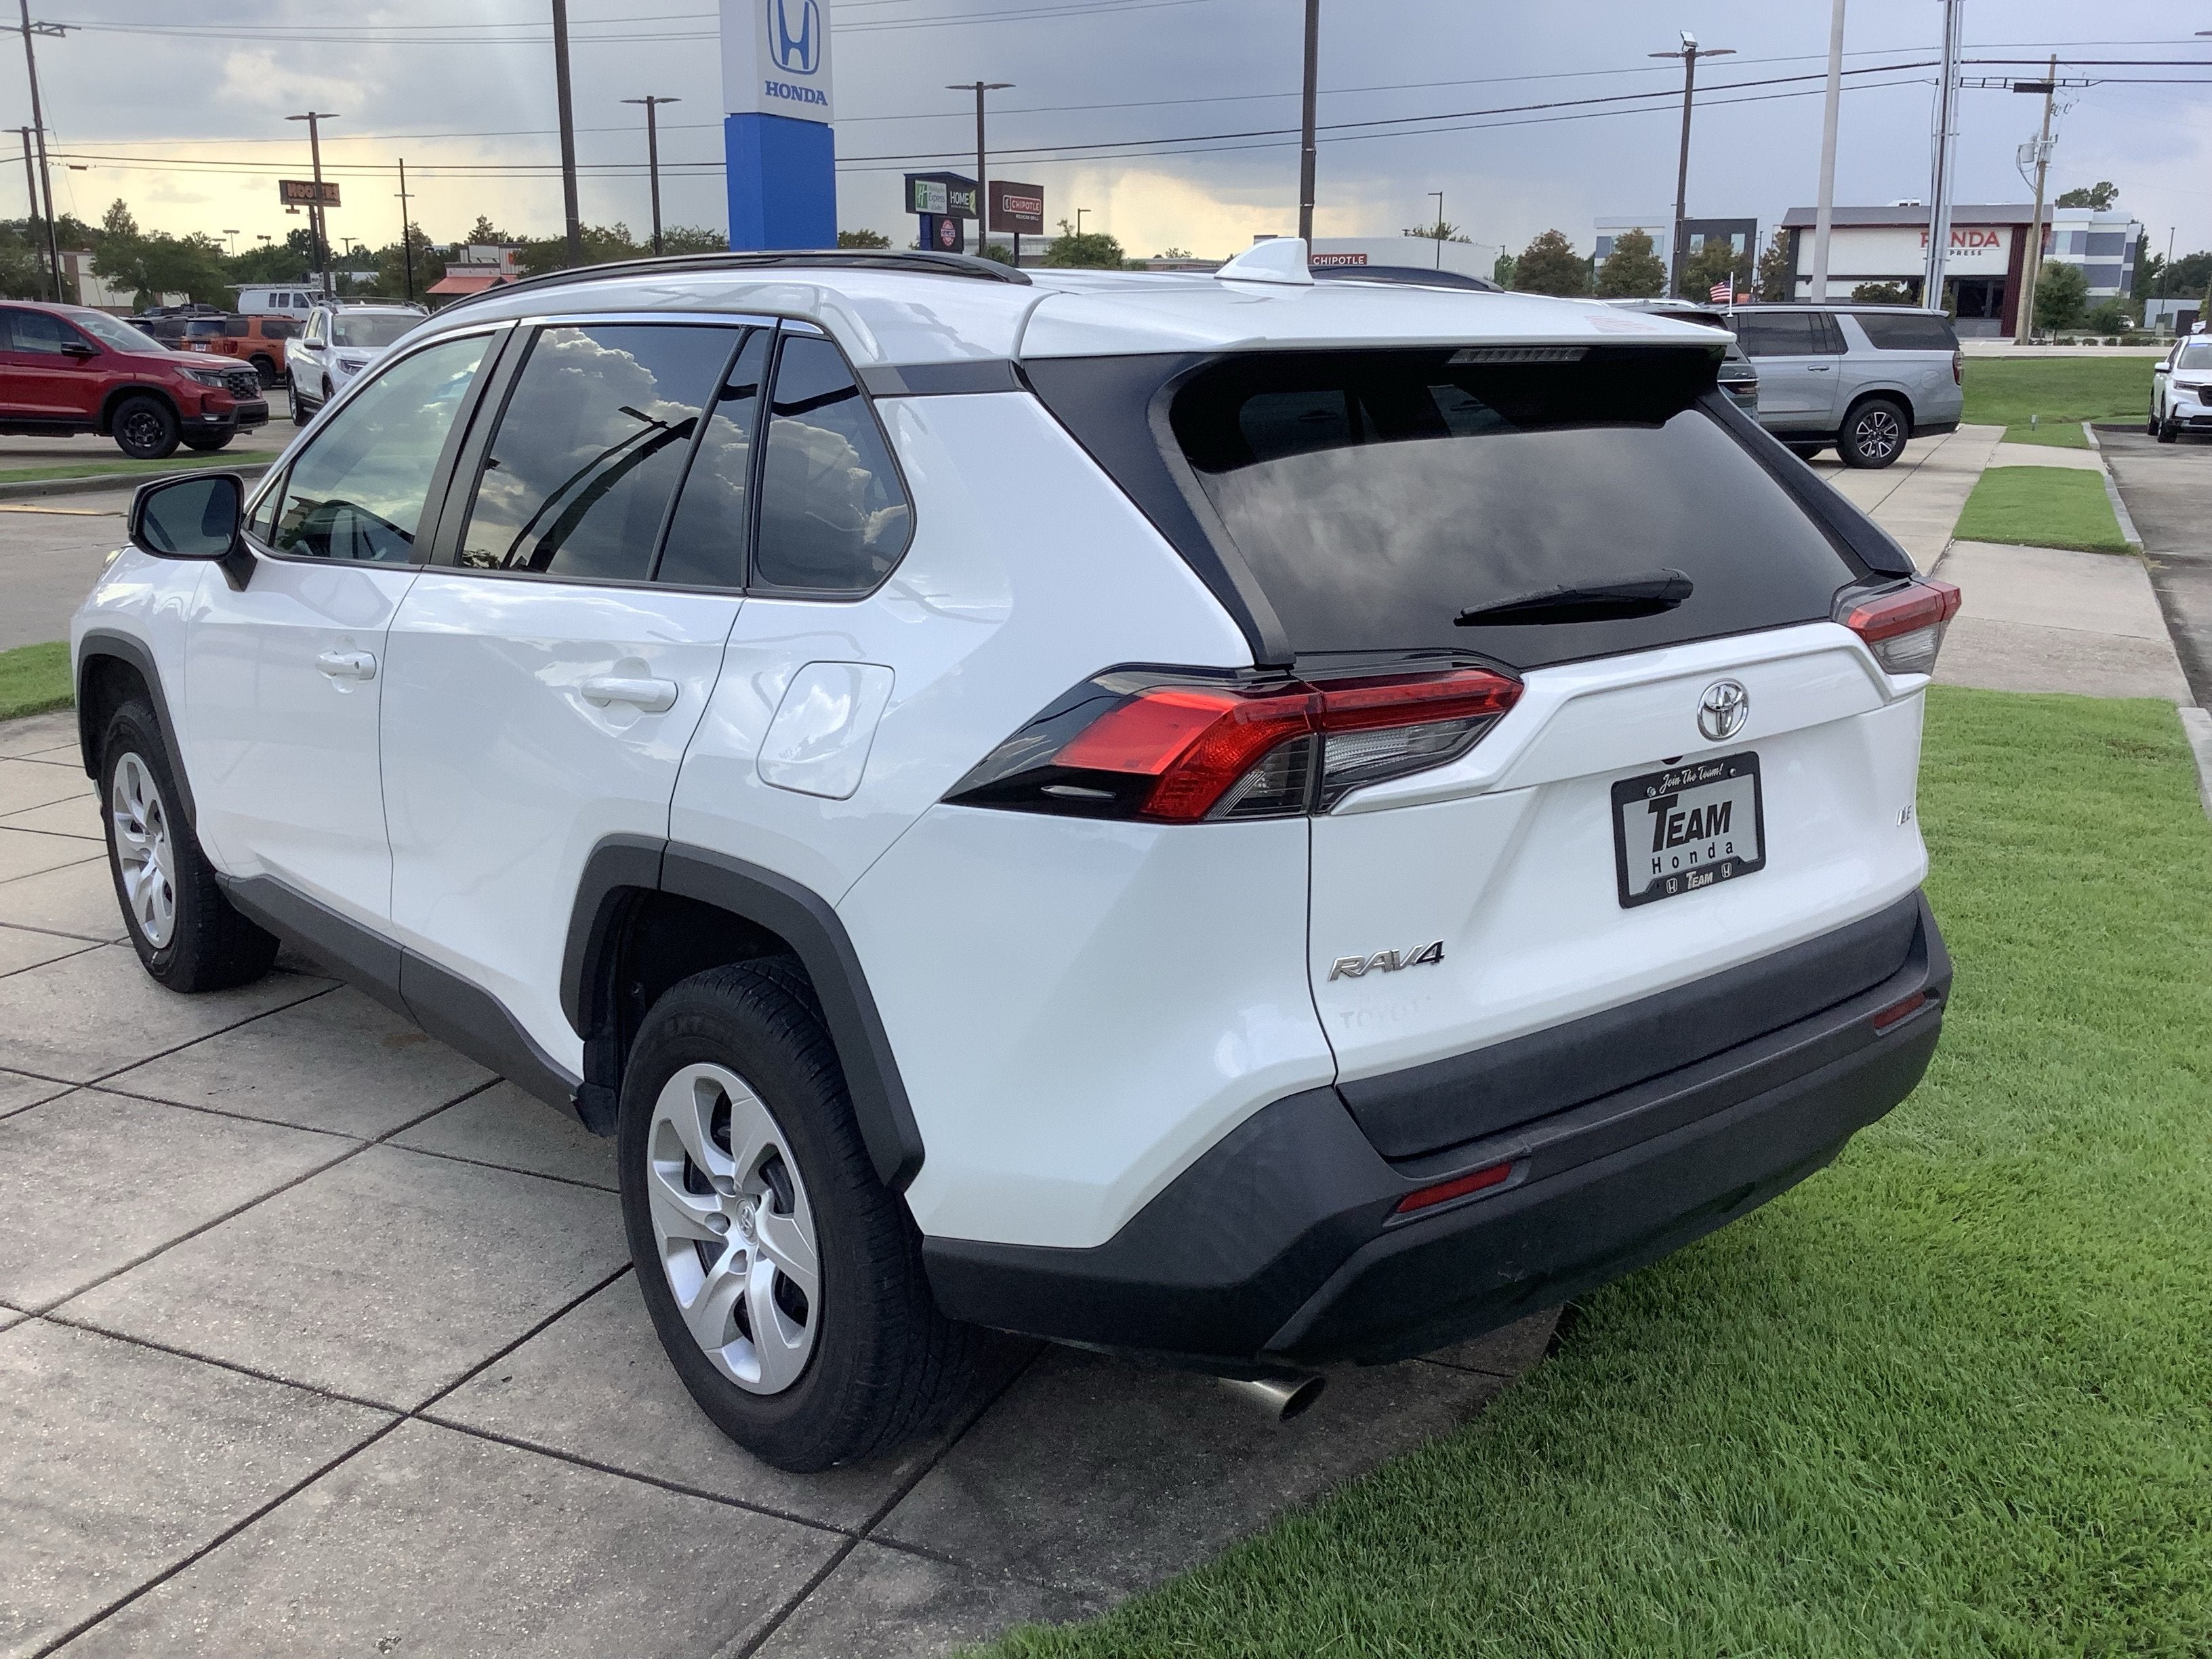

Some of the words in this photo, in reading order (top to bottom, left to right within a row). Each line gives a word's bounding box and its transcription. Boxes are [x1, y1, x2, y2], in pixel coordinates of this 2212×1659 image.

[765, 80, 828, 106] HONDA
[950, 191, 969, 206] HOME
[1012, 200, 1040, 211] CHIPOTLE
[1920, 230, 2000, 247] PNDA
[1313, 256, 1364, 265] CHIPOTLE
[1659, 773, 1681, 794] Join
[1681, 769, 1697, 784] The
[1698, 762, 1724, 780] Team!
[1647, 793, 1732, 853] TEAM
[1897, 804, 1912, 827] LE
[1652, 841, 1734, 875] Honda
[1685, 871, 1713, 890] TEAM
[1328, 939, 1446, 982] RAV4
